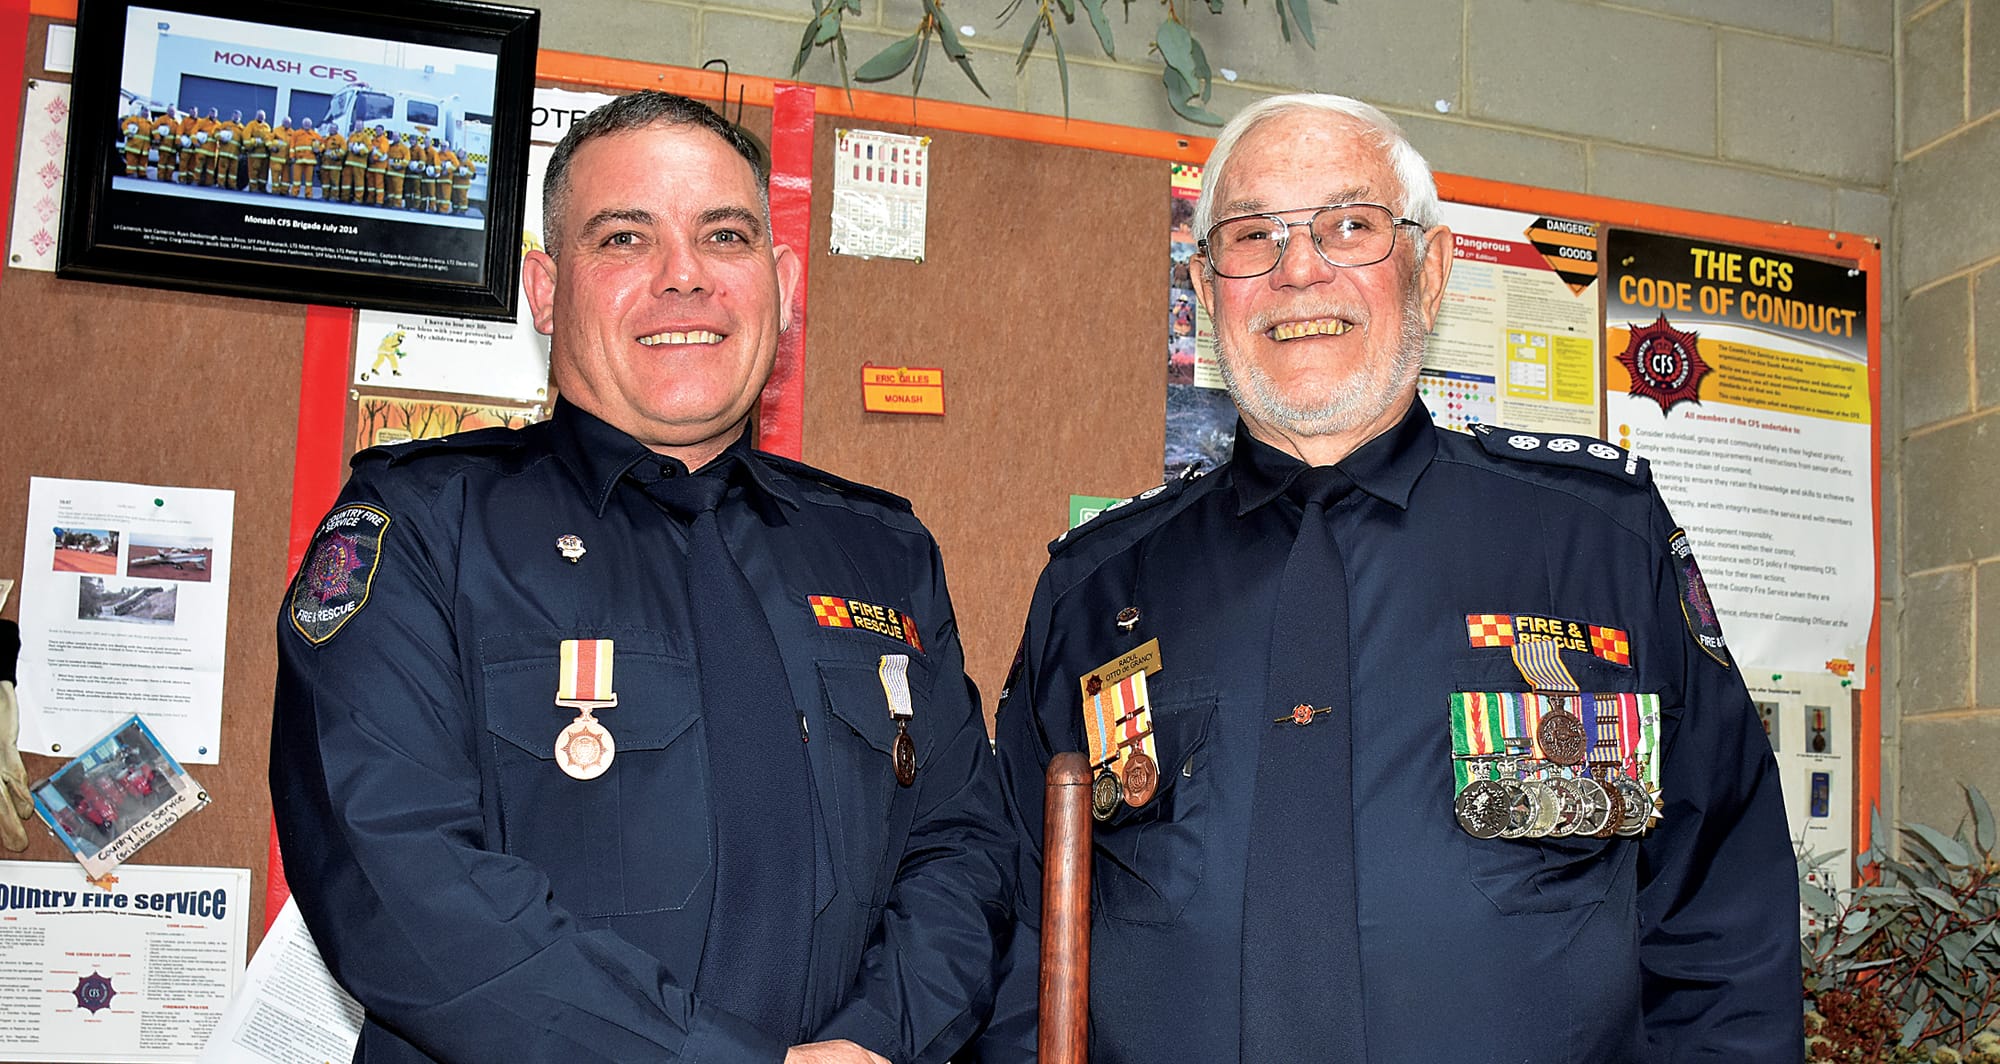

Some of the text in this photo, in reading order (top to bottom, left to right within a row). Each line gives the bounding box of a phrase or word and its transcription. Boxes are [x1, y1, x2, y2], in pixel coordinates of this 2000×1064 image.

[214, 50, 358, 82] MONASH CFS
[244, 214, 359, 234] Monash CFS Brigade July 2014
[1456, 236, 1511, 252] Dangerous
[1559, 246, 1593, 261] GOODS
[1691, 247, 1794, 292] THE CFS
[1618, 275, 1693, 312] CODE
[1699, 285, 1734, 316] OF
[1740, 290, 1857, 338] CONDUCT
[429, 318, 443, 326] have
[466, 322, 476, 330] my
[449, 328, 464, 336] your
[465, 330, 496, 340] protecting
[428, 335, 454, 343] children
[1652, 354, 1674, 375] CFS
[875, 374, 896, 383] ERIC
[884, 394, 924, 404] MONASH
[1684, 411, 1695, 420] All
[1696, 413, 1728, 424] members
[1729, 416, 1736, 424] of
[1736, 417, 1747, 426] the
[1748, 419, 1760, 428] CFS
[1761, 422, 1793, 433] undertake
[1635, 427, 1664, 438] Consider
[1697, 436, 1716, 445] group
[1730, 439, 1762, 450] community
[1762, 443, 1780, 453] safety
[1789, 447, 1801, 455] their
[1802, 448, 1823, 459] highest
[1635, 441, 1829, 473] Comply with reasonable requirements and instructions from senior
[1662, 460, 1683, 468] within
[1683, 460, 1694, 469] the
[1695, 462, 1712, 470] chain
[1659, 474, 1683, 483] training
[1691, 477, 1713, 485] ensure
[1714, 478, 1728, 487] they
[1729, 480, 1748, 488] retain
[1758, 483, 1789, 495] knowledge
[1790, 487, 1801, 496] and
[1801, 489, 1815, 498] skills
[1823, 493, 1844, 502] achieve
[1845, 495, 1855, 503] the
[361, 510, 385, 527] FIRE
[1697, 501, 1709, 509] and
[1710, 502, 1725, 510] with
[1726, 504, 1751, 514] integrity
[1751, 507, 1770, 515] within
[1770, 508, 1780, 517] the
[1780, 510, 1801, 520] service
[1801, 512, 1812, 521] and
[1812, 514, 1826, 522] with
[1826, 516, 1853, 526] members
[1705, 526, 1738, 536] equipment
[1698, 540, 1716, 548] public
[1740, 544, 1759, 552] within
[1760, 545, 1774, 553] their
[1701, 554, 1737, 564] accordance
[1738, 556, 1752, 564] with
[1752, 557, 1765, 567] CFS
[1765, 559, 1782, 568] policy
[1788, 563, 1825, 574] representing
[1719, 582, 1729, 590] the
[1730, 583, 1754, 594] Country
[1754, 585, 1766, 594] Fire
[1767, 587, 1789, 597] Service
[1790, 589, 1806, 598] when
[1807, 592, 1820, 601] they
[296, 608, 315, 623] FIRE
[317, 599, 357, 623] RESCUE
[847, 599, 900, 626] FIRE &
[1738, 609, 1758, 618] inform
[1759, 611, 1774, 620] their
[1774, 612, 1811, 626] Commanding
[1812, 615, 1832, 626] Officer
[853, 615, 905, 641] RESCUE
[1515, 615, 1584, 640] FIRE &
[1699, 633, 1717, 649] FIRE
[1105, 652, 1154, 682] OTTO de GRANCY
[1118, 653, 1139, 668] RAOUL
[97, 795, 186, 861] Country Fire Service
[82, 892, 129, 908] Fire
[134, 888, 228, 921] service
[88, 987, 100, 998] CFS
